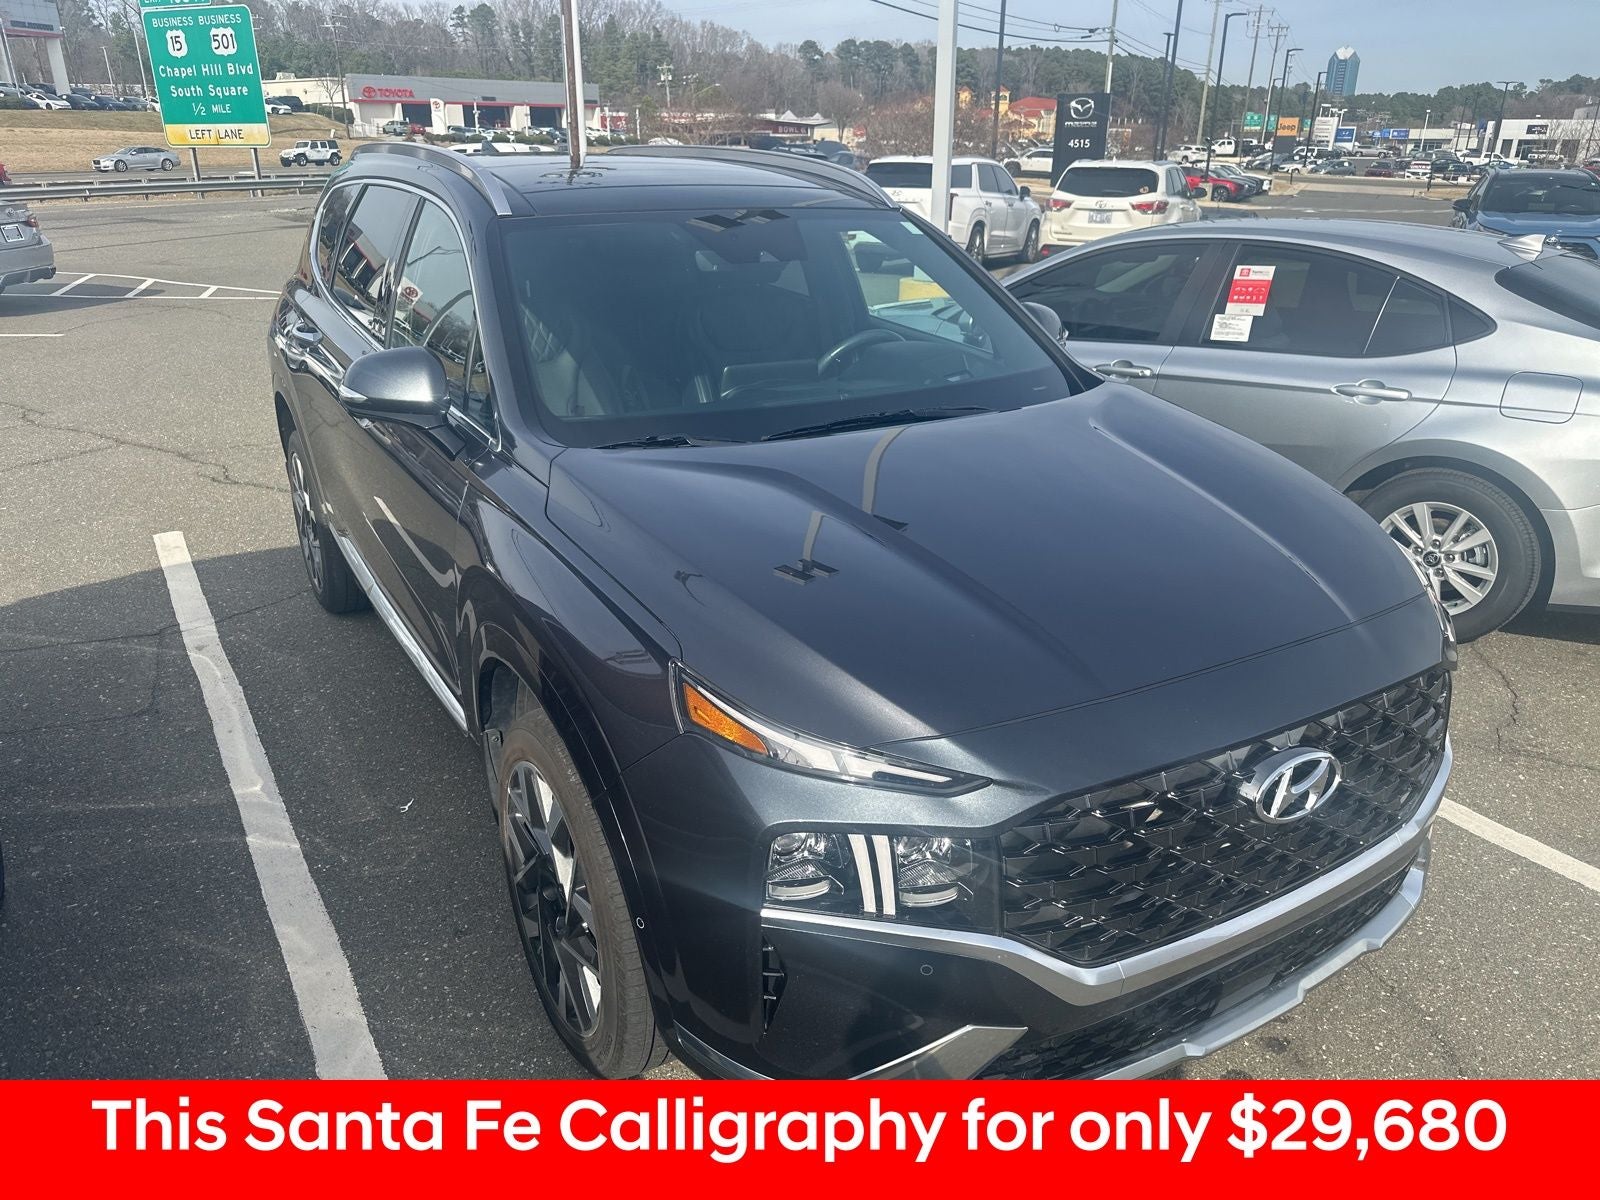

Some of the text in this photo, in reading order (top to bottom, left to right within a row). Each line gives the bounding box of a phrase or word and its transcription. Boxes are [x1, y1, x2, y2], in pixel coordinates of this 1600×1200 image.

[152, 13, 242, 27] BUSINESS BUSINESS
[170, 35, 183, 52] 15
[212, 33, 236, 50] 501
[158, 62, 254, 79] Chapel Hill Blvd
[170, 84, 249, 99] South Square
[377, 88, 416, 98] TOYOTA
[211, 104, 232, 114] MILE
[189, 128, 245, 140] LEFT LANE
[1277, 123, 1297, 132] Jeep
[1068, 138, 1091, 148] 4515
